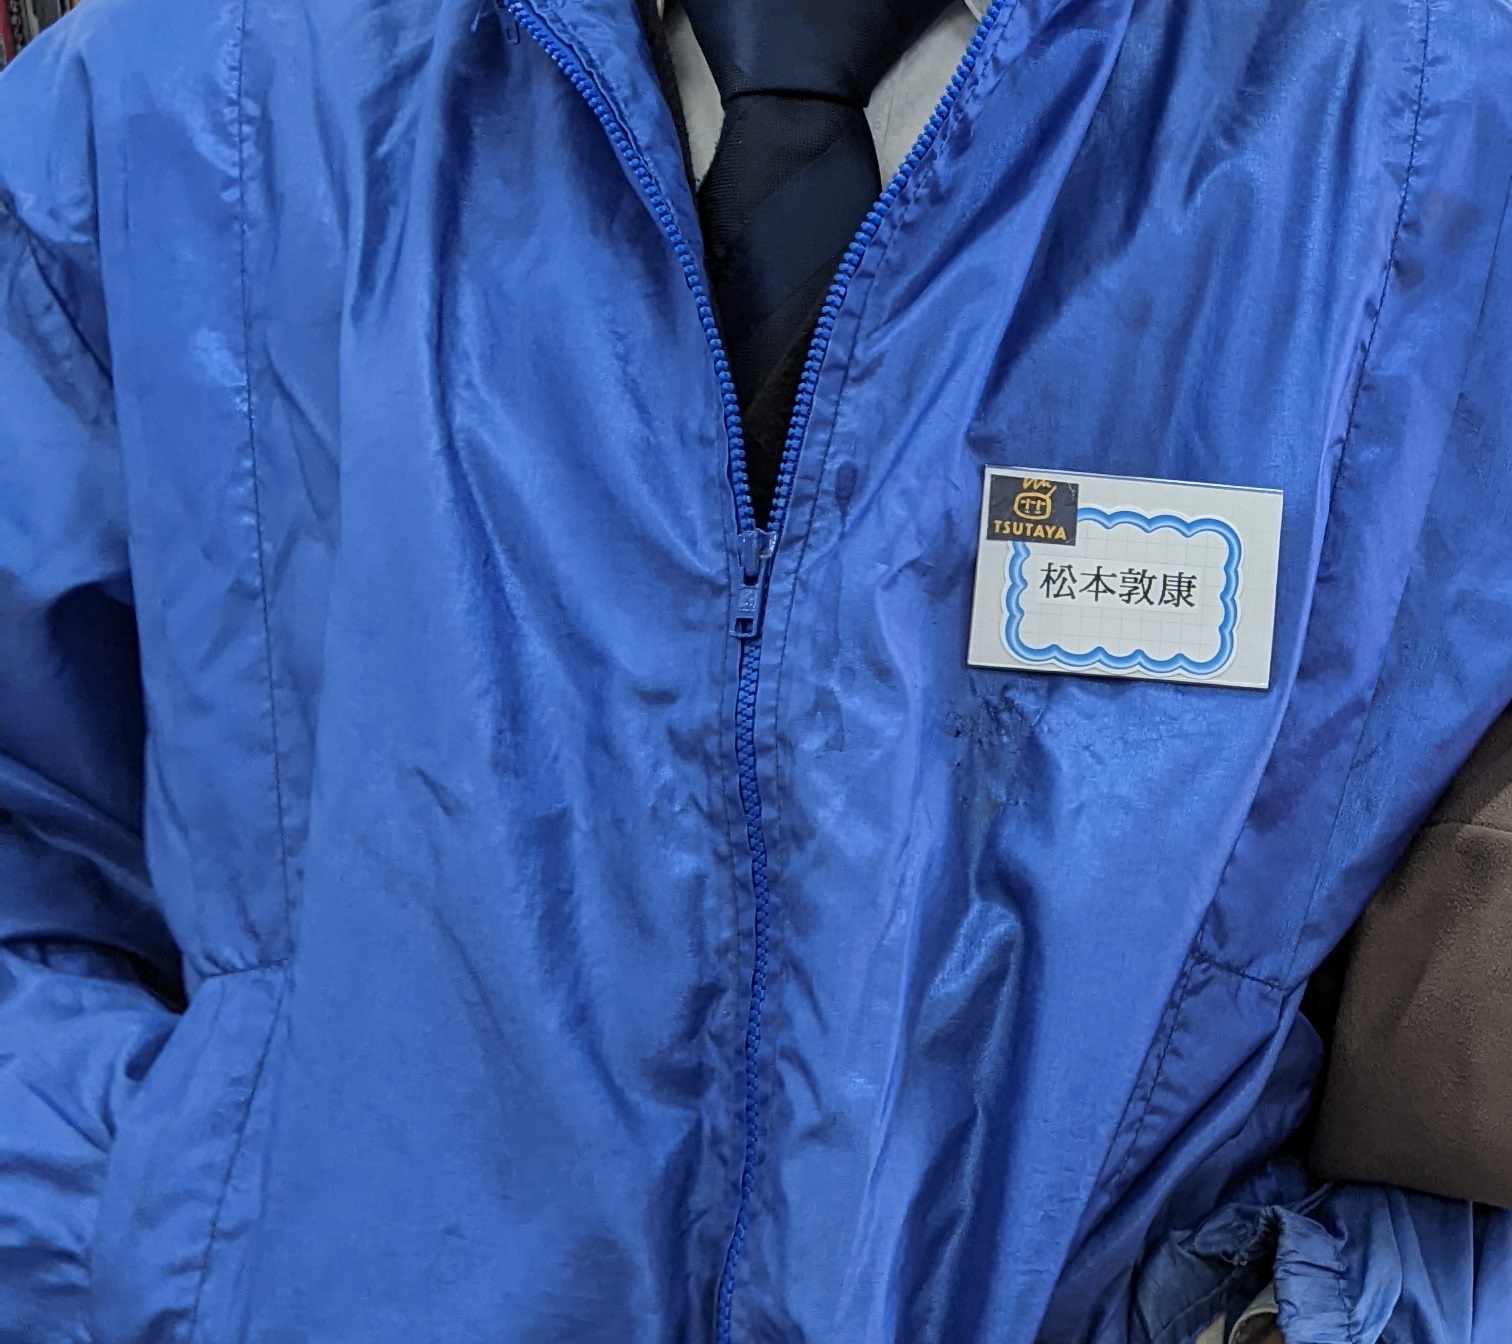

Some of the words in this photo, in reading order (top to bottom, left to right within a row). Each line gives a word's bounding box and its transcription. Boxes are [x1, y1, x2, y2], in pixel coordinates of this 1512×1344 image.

[993, 519, 1068, 541] TSUTAYA
[1039, 562, 1198, 609] 松本敦康
